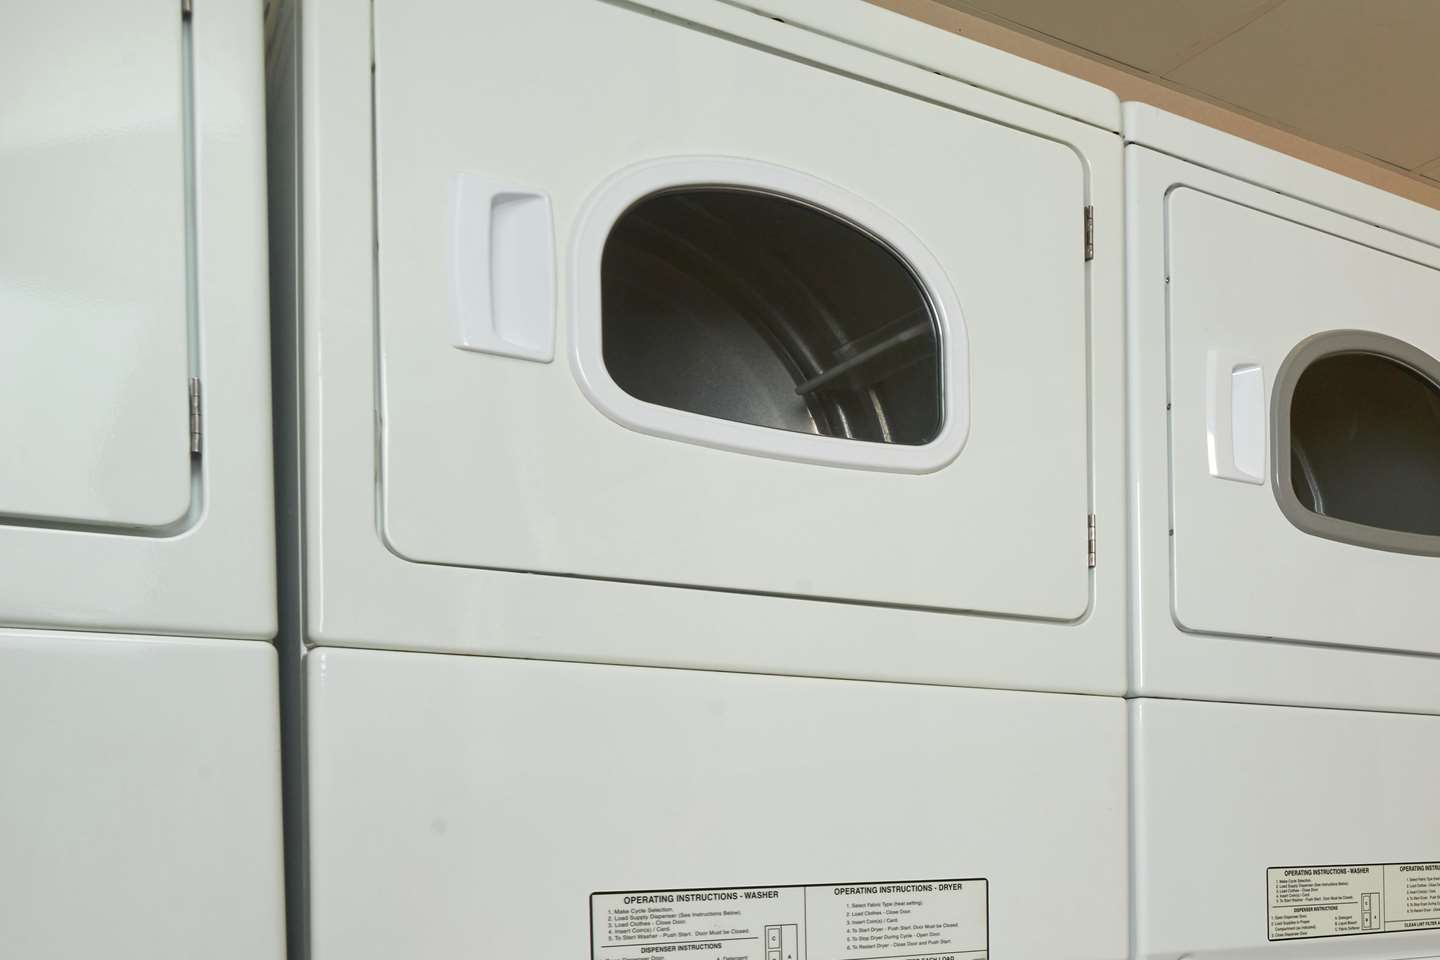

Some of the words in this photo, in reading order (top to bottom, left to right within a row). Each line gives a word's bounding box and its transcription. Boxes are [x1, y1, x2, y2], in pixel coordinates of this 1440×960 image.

[834, 887, 878, 895] OPERATING
[879, 884, 933, 893] INSTRUCTIONS
[624, 894, 674, 904] OPERATING
[676, 892, 738, 902] INSTRUCTIONS
[744, 891, 779, 899] WASHER
